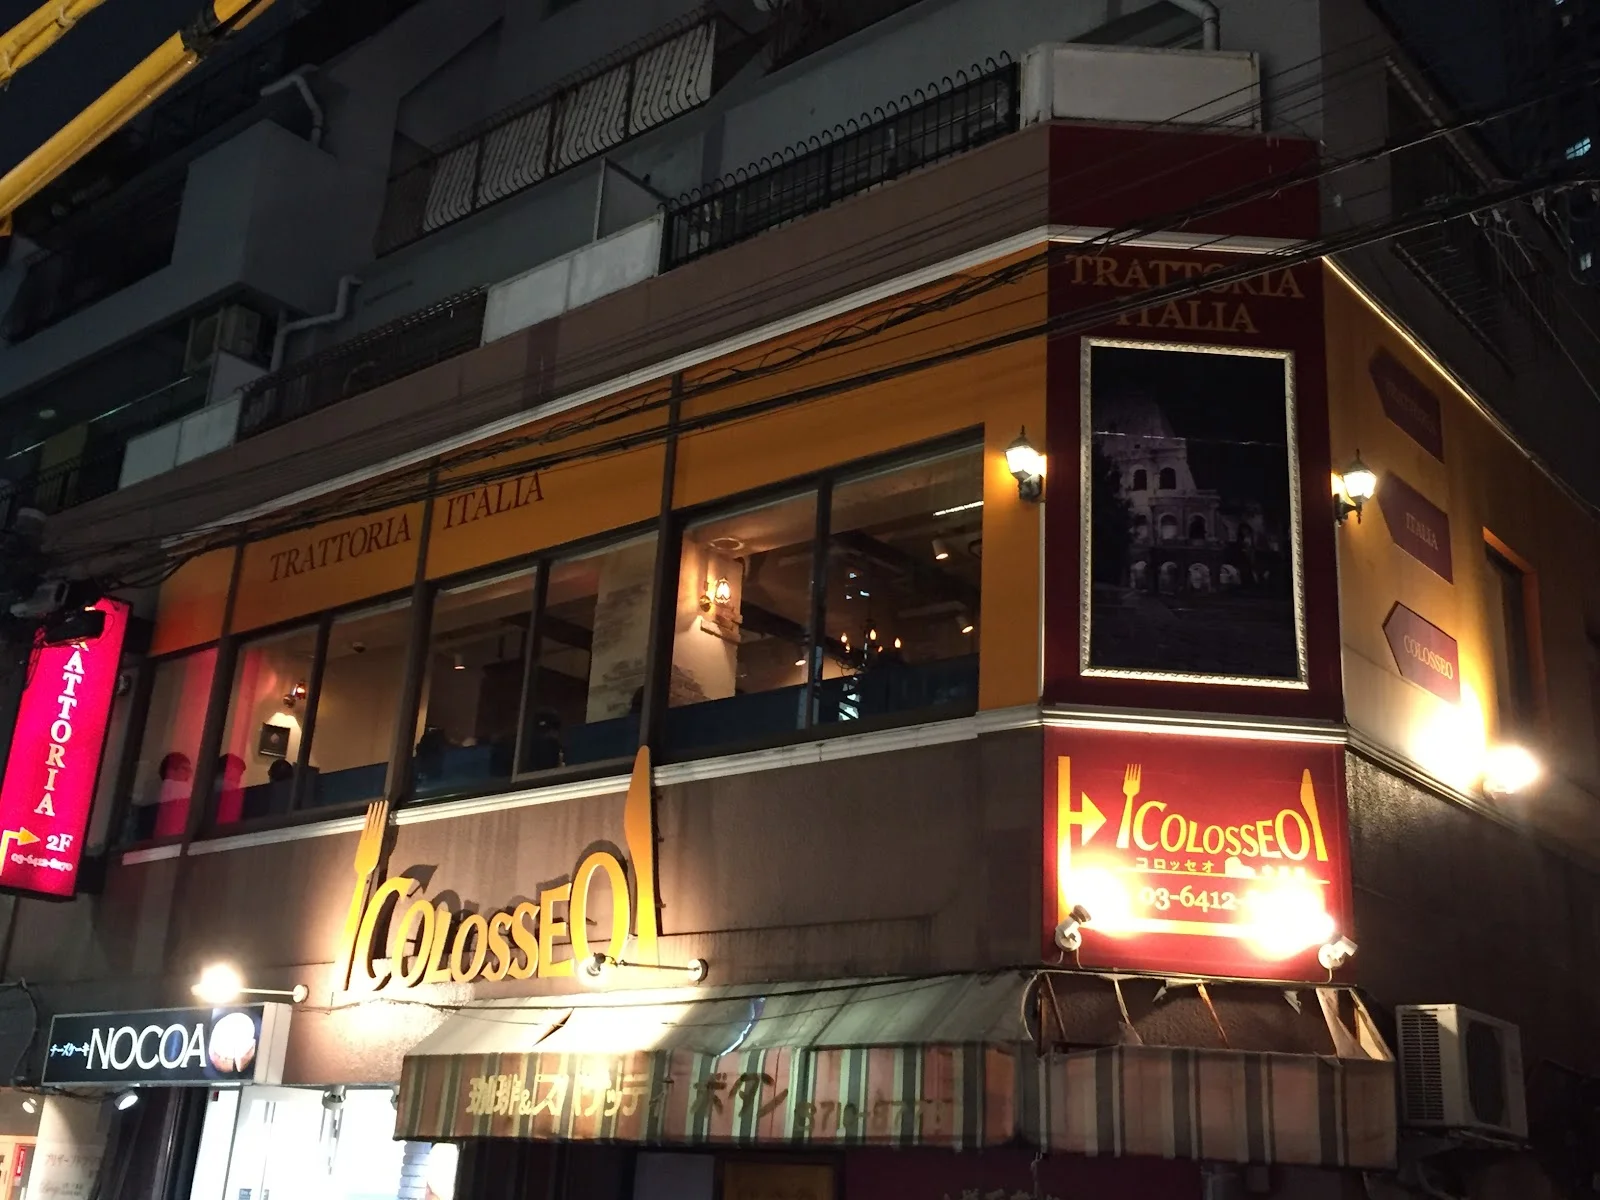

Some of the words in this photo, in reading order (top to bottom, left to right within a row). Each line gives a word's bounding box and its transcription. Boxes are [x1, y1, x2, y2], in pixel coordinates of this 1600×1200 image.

[269, 513, 412, 583] TRATTORIA
[443, 471, 545, 530] ITALIA
[1405, 512, 1439, 551] ITALIA
[1403, 634, 1454, 680] COLOSSEO
[33, 642, 89, 817] ATTORIA
[45, 834, 73, 853] 2F
[1132, 800, 1311, 861] COLOSSEO
[1135, 856, 1215, 874] コロッセオ
[354, 850, 631, 991] COLOSSEO
[86, 1023, 207, 1070] NOCOA
[689, 1071, 789, 1119] ボタン
